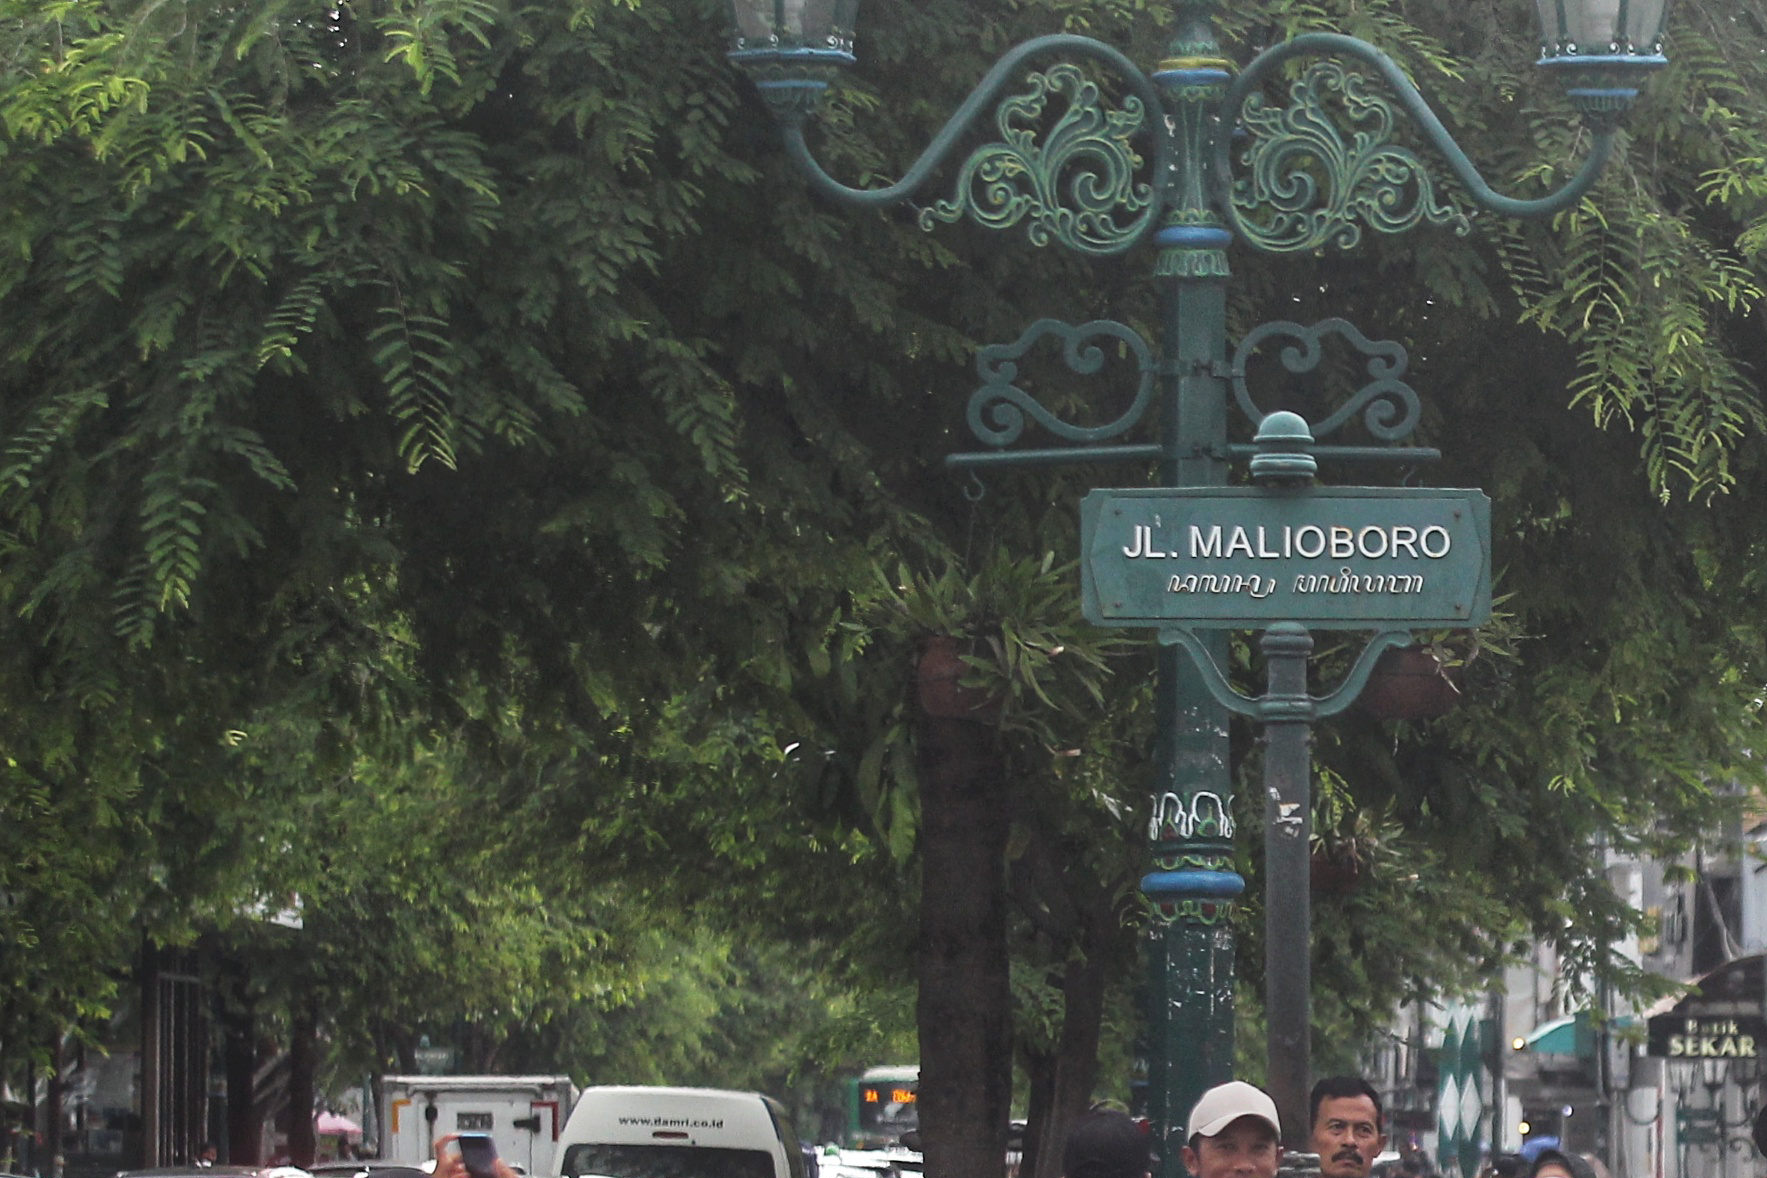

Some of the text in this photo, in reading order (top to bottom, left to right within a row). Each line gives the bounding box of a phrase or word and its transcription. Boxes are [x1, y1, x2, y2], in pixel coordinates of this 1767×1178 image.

[1123, 525, 1451, 559] JL. MALIOBORO
[1669, 1035, 1757, 1057] SEKAR
[618, 1116, 724, 1129] www.damri.co.id
